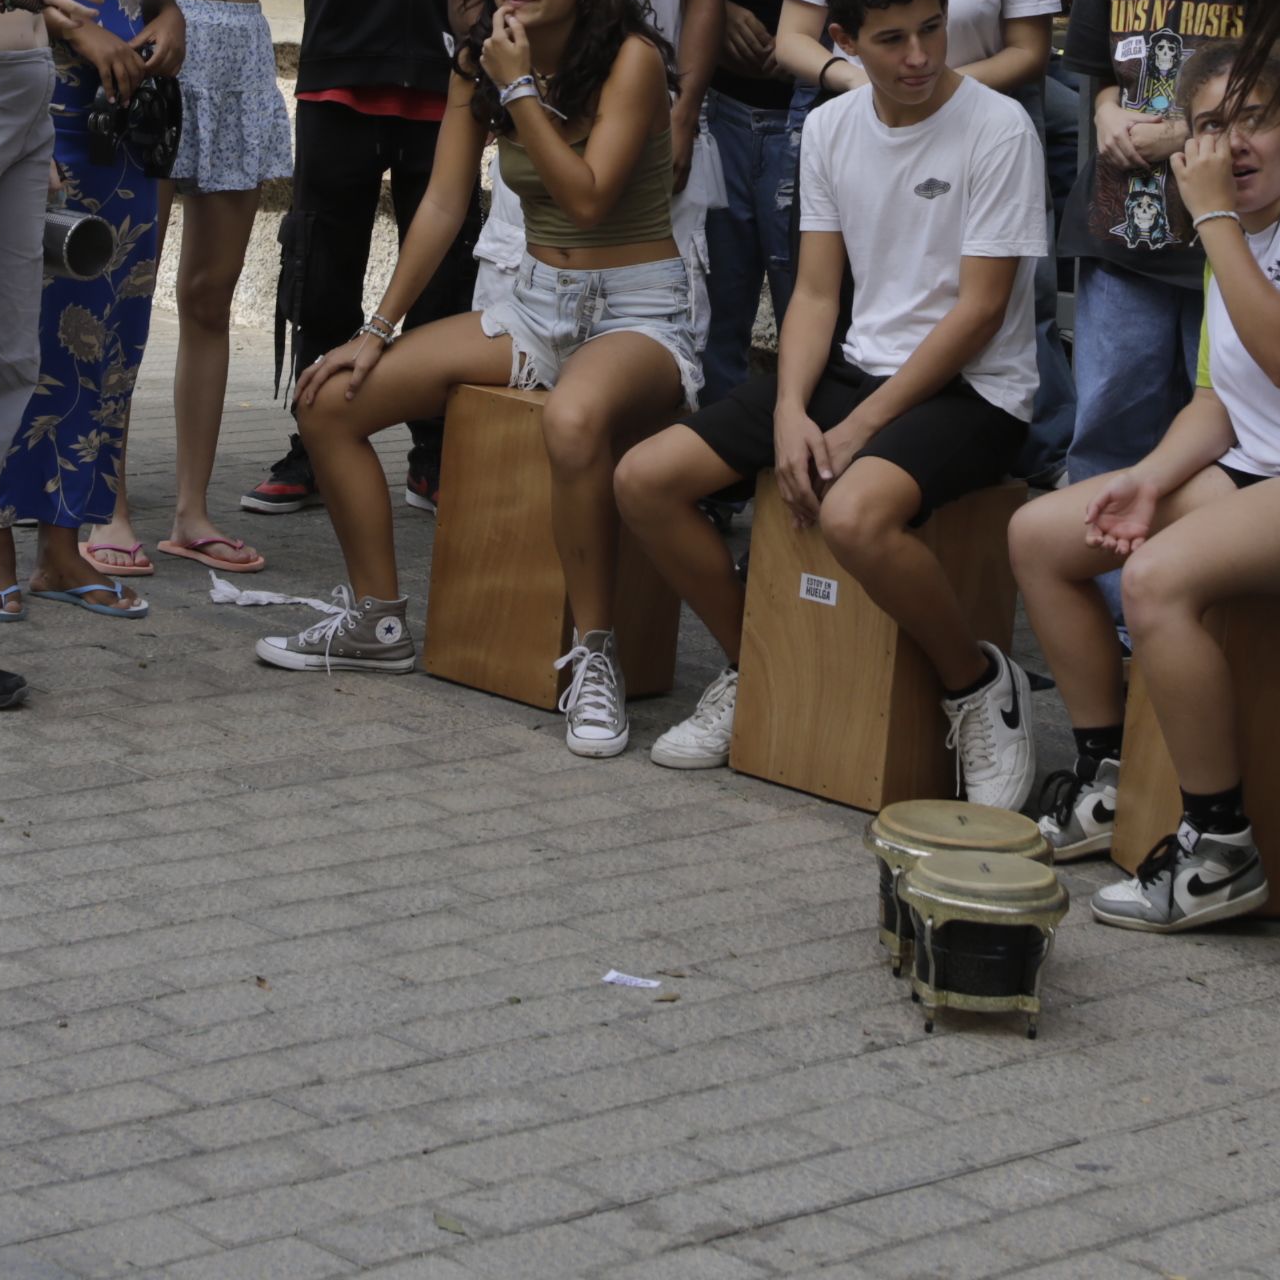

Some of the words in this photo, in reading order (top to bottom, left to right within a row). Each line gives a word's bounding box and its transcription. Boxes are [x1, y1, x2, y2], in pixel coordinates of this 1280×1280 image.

[1179, 0, 1245, 39] ROSES
[806, 576, 824, 589] ESTOY
[824, 581, 832, 591] EN
[805, 586, 831, 601] HUELGA
